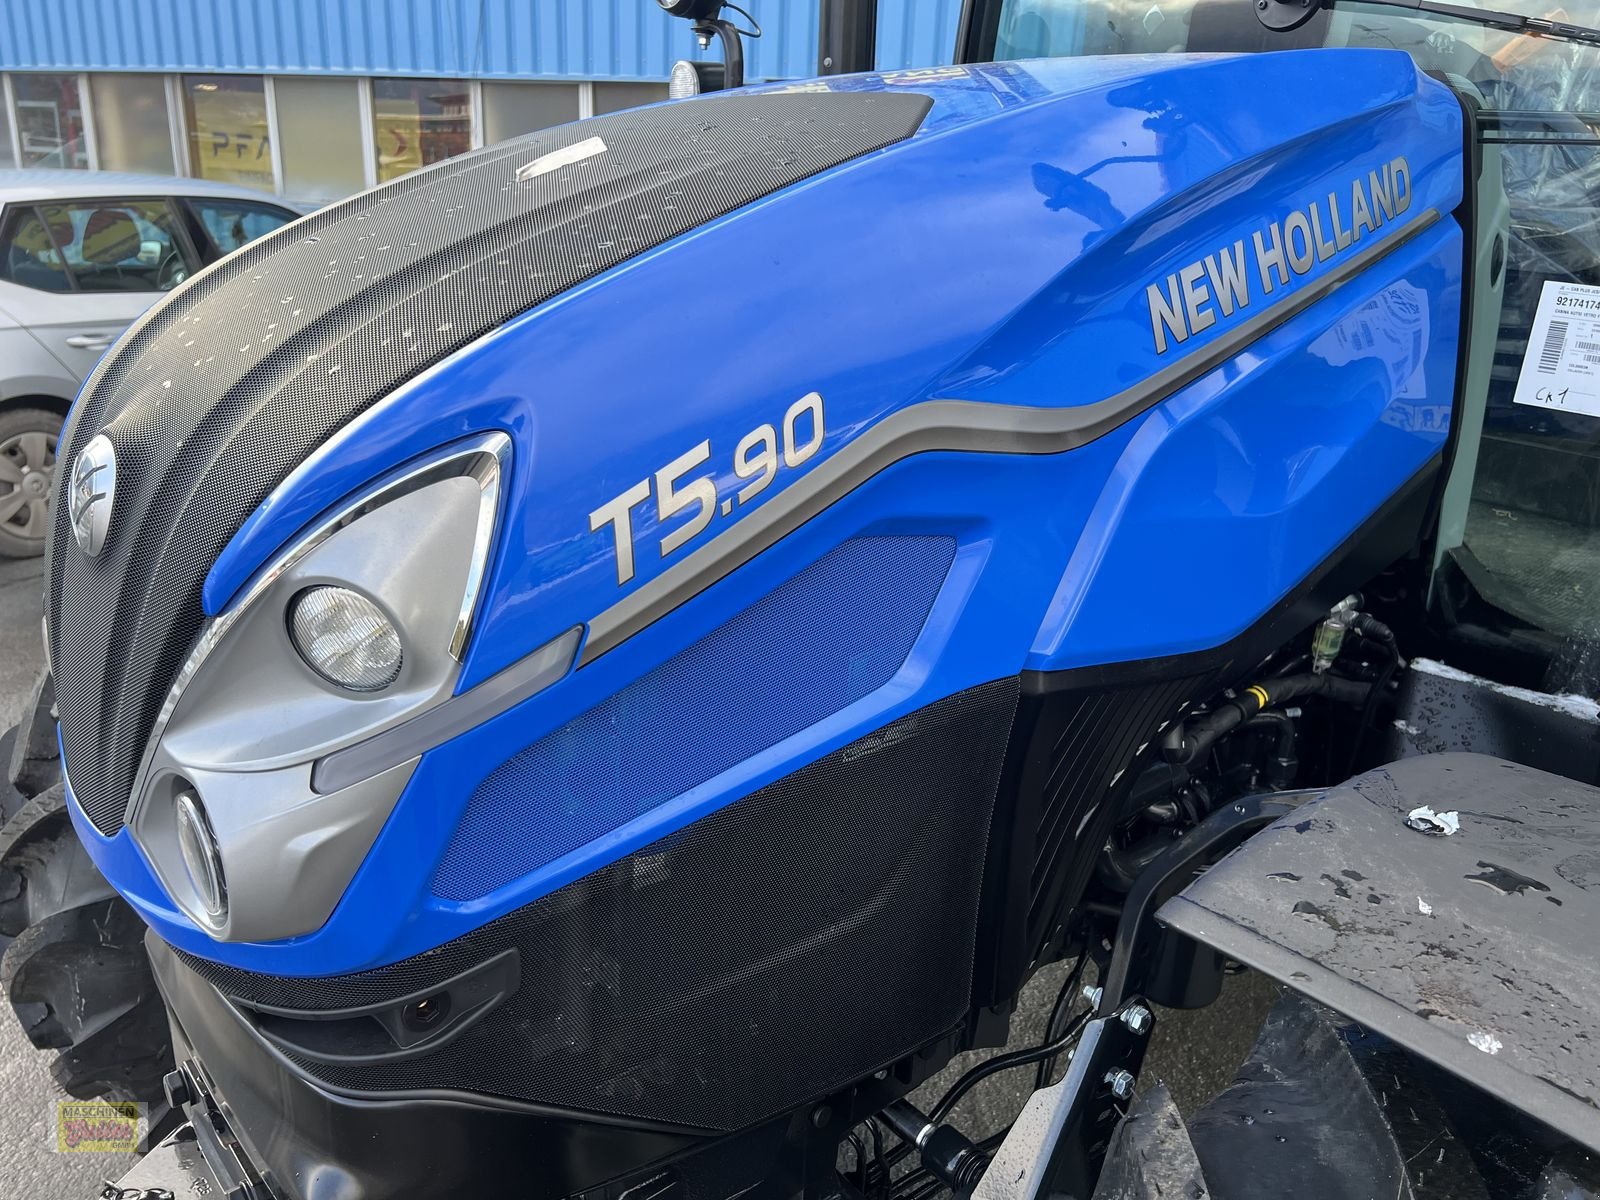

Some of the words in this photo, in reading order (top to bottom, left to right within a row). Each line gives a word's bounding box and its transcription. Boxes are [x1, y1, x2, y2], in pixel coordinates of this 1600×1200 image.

[1146, 239, 1250, 355] NEW
[1252, 155, 1412, 295] HOLLAND
[588, 391, 825, 587] T5.90
